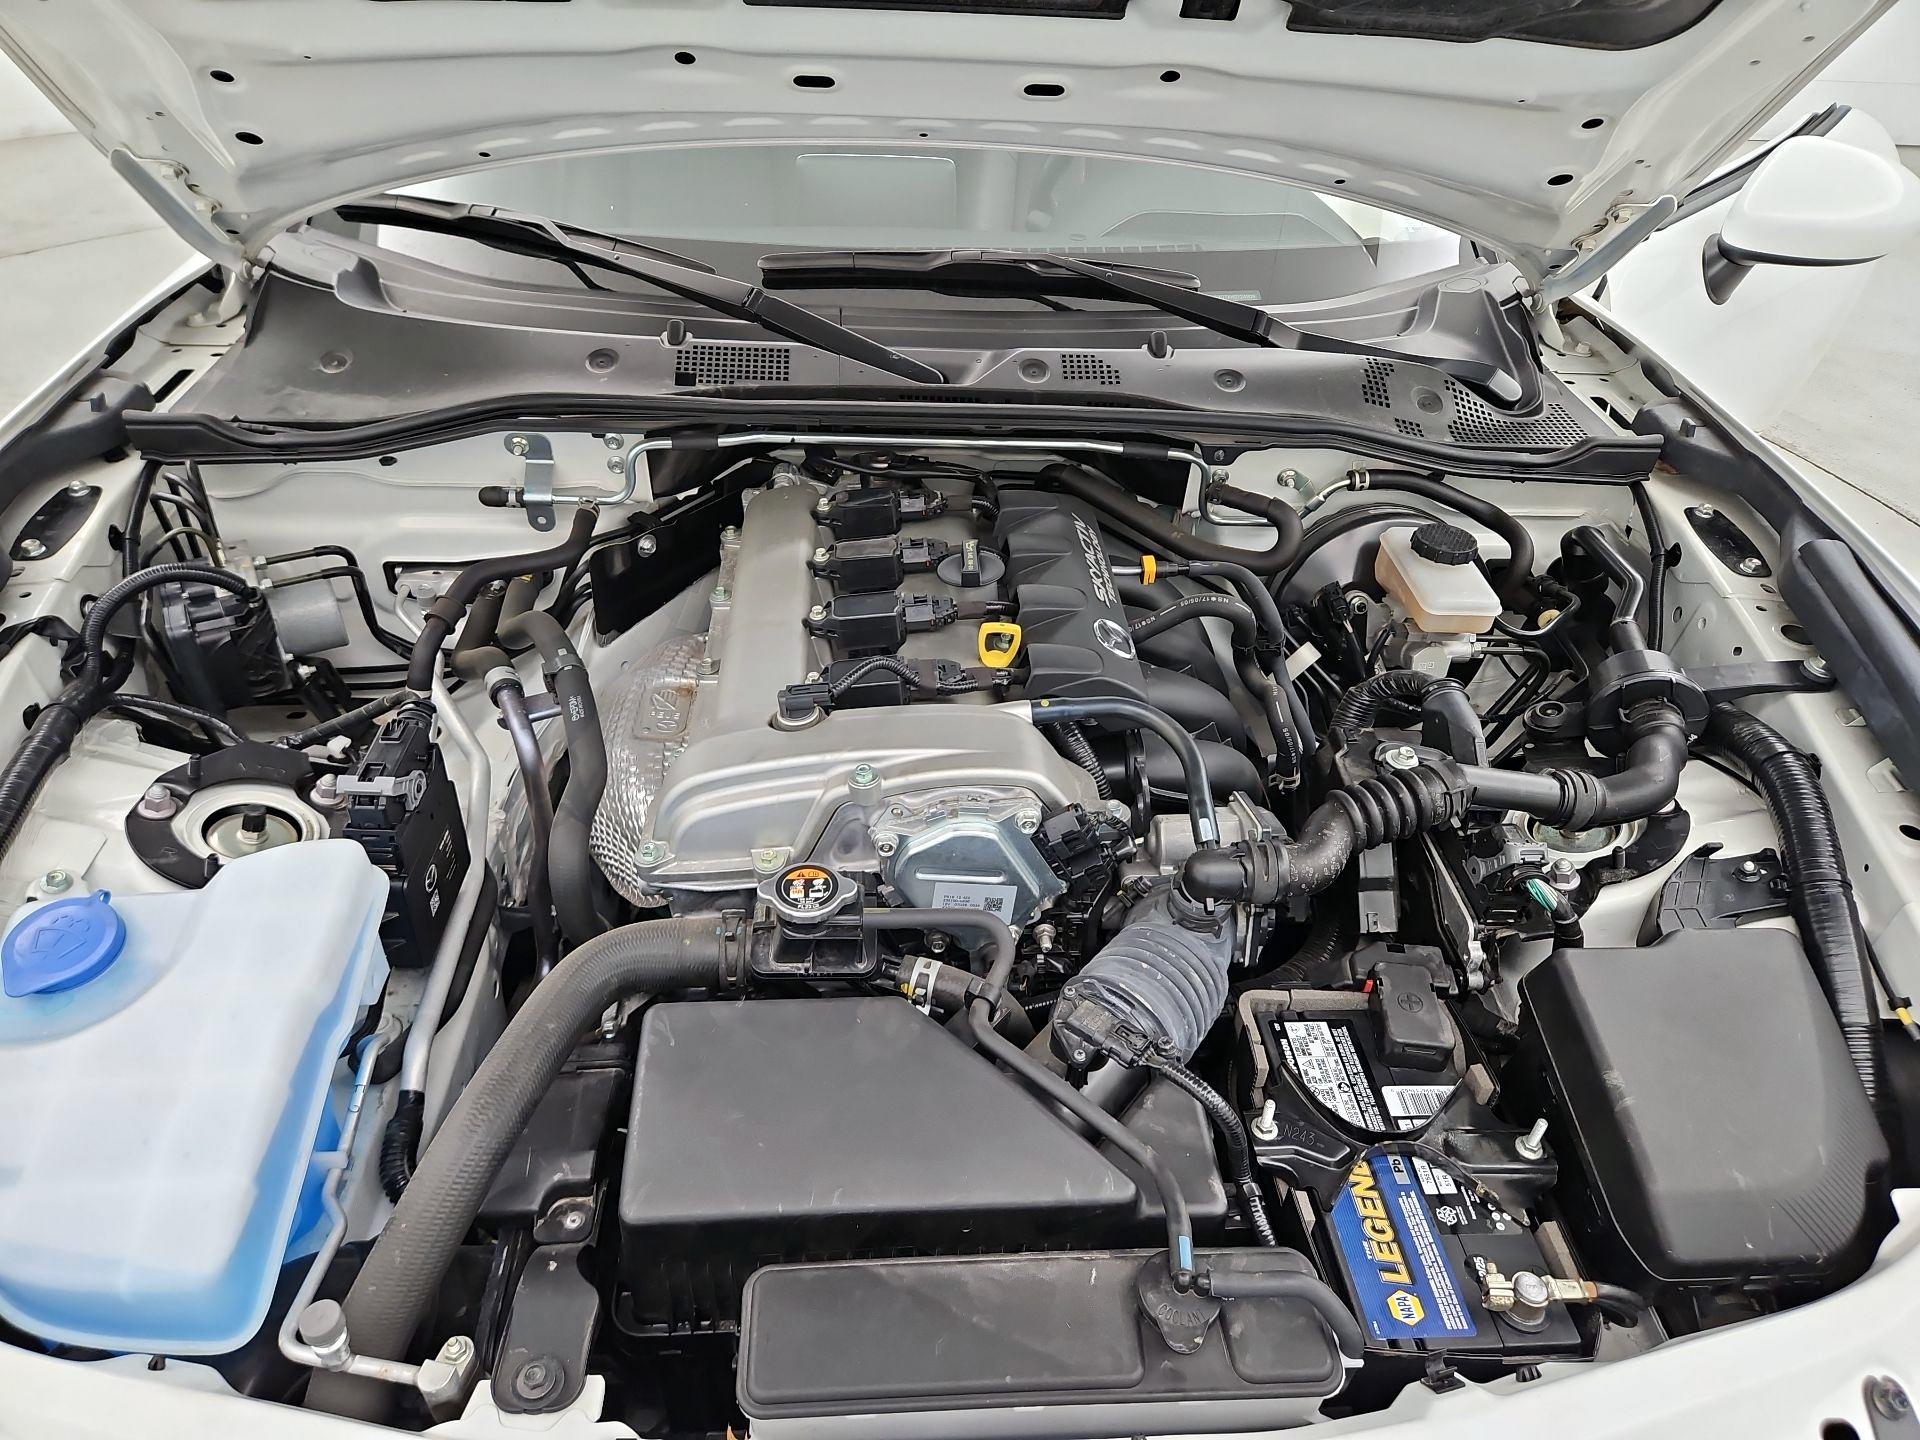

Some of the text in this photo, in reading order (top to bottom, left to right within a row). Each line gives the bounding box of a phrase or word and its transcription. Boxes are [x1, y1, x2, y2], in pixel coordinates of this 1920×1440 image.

[1071, 512, 1111, 608] SKYACTIV
[1087, 525, 1118, 603] TECHNOLOGY
[1393, 1158, 1406, 1174] Pb
[1362, 1238, 1372, 1260] THE
[1398, 1295, 1416, 1320] NAPA
